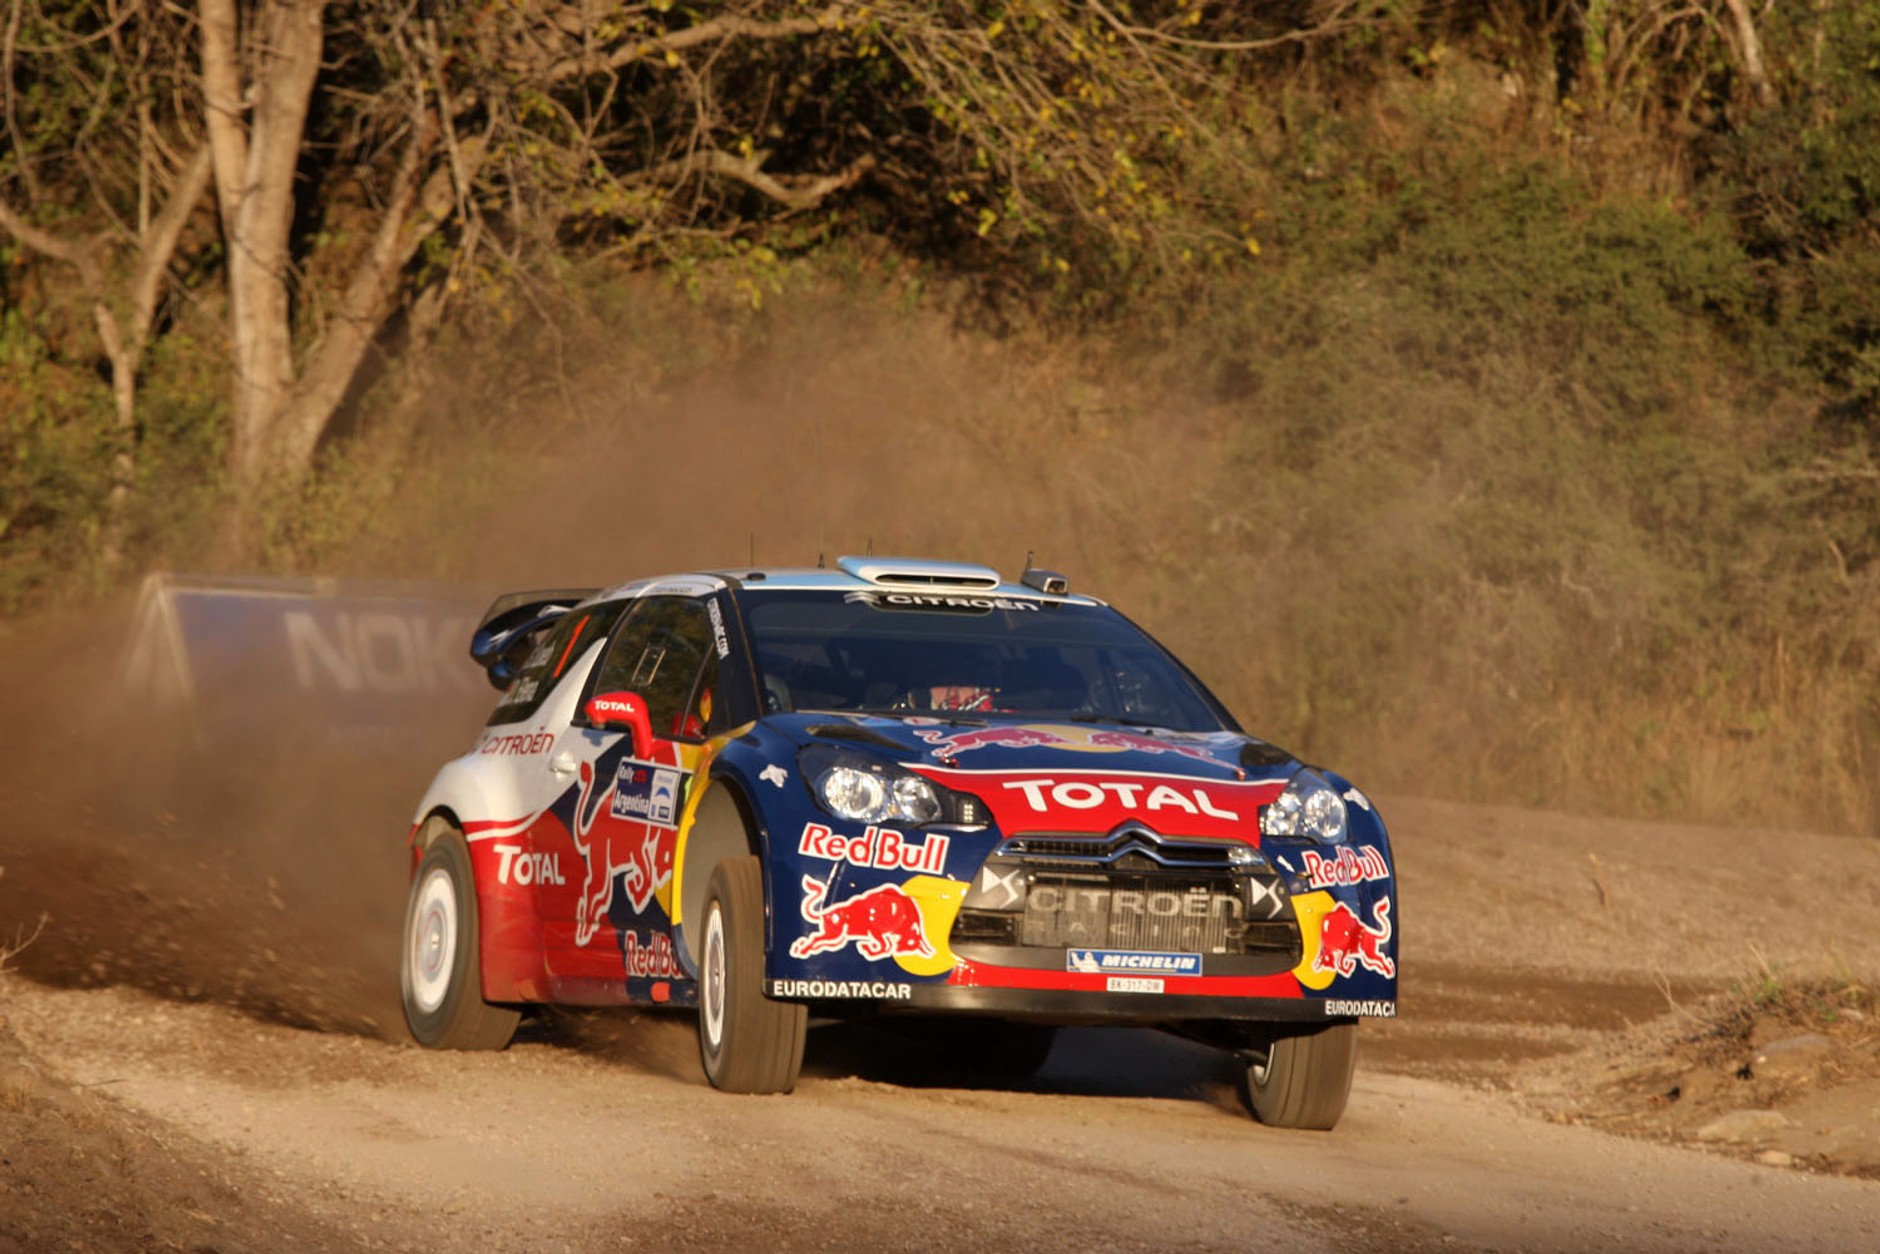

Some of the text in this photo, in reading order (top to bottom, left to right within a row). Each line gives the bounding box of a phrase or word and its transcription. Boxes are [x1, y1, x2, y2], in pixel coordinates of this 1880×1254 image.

[283, 610, 479, 692] NOK
[594, 700, 635, 713] TOTAL
[1002, 778, 1239, 821] TOTAL
[494, 844, 566, 886] TOTAL
[1101, 954, 1197, 970] MICHELIN
[773, 981, 912, 999] EURODATACAR
